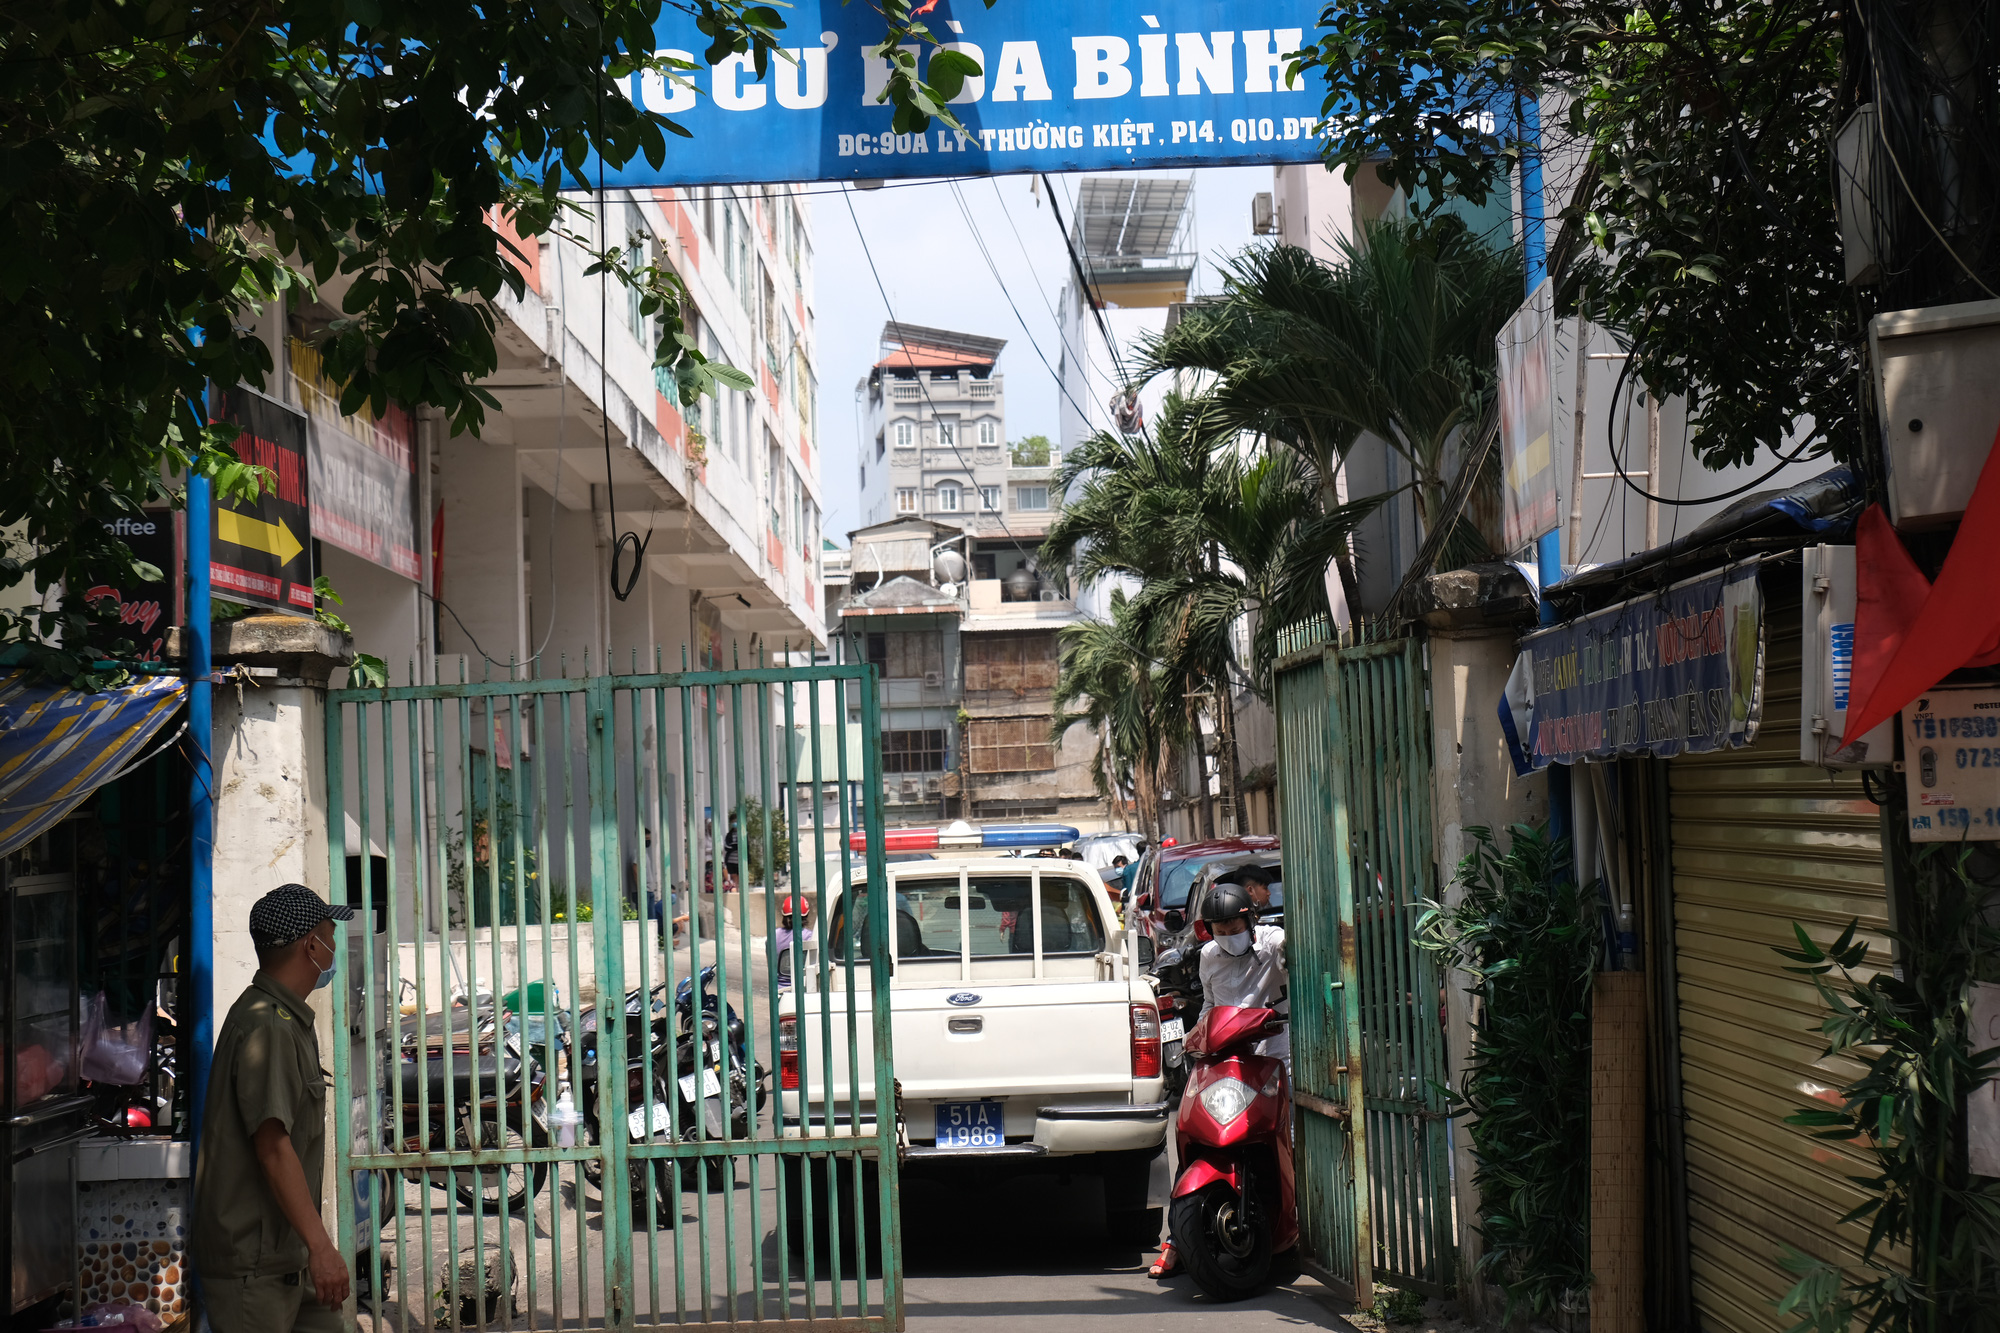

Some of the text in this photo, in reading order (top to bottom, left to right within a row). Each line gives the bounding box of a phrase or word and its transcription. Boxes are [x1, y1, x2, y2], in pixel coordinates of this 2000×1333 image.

[1071, 15, 1306, 100] BÌNH
[937, 123, 970, 153] LÝ
[979, 118, 1083, 153] THƯỜNG
[277, 445, 300, 505] MINH
[300, 455, 307, 507] 2
[950, 1104, 989, 1126] 51A
[945, 1125, 997, 1147] 1986
